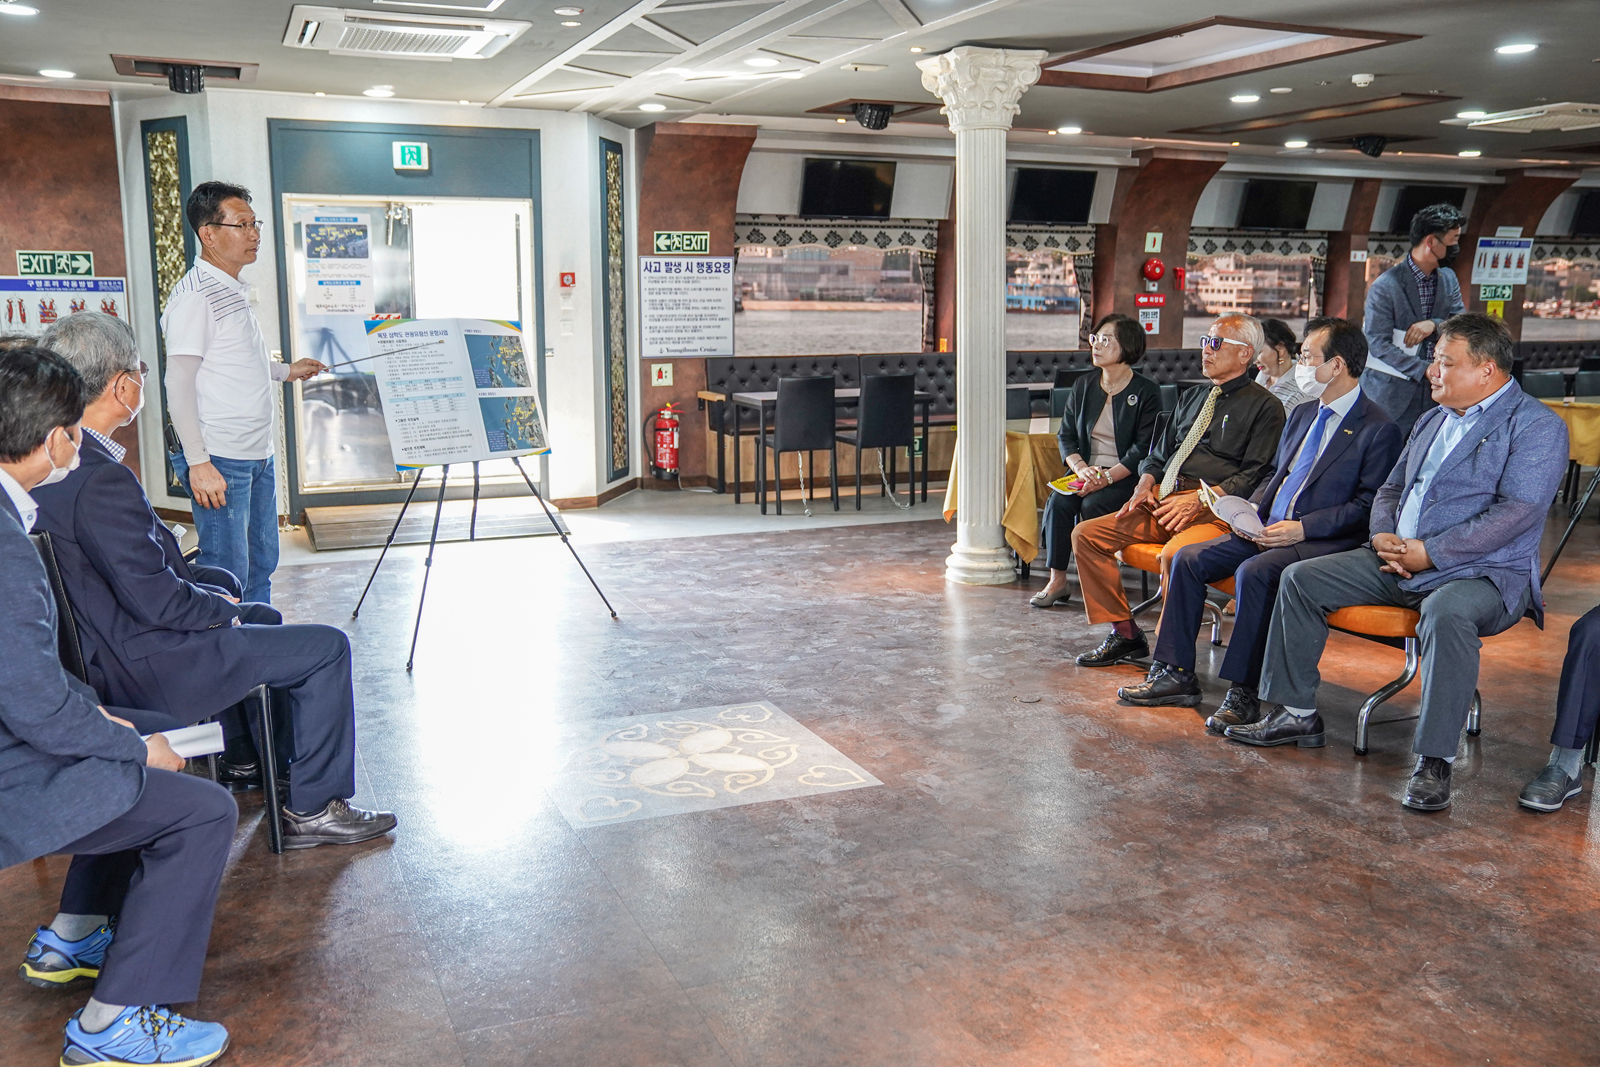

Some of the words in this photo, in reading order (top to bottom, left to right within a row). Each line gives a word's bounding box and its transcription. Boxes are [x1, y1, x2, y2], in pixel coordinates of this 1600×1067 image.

[683, 235, 708, 250] EXIT
[19, 254, 54, 273] EXIT
[643, 261, 661, 273] 사고
[664, 261, 682, 273] 발생
[685, 261, 693, 273] 시
[696, 262, 731, 274] 행동요령
[1482, 286, 1496, 298] EXIT
